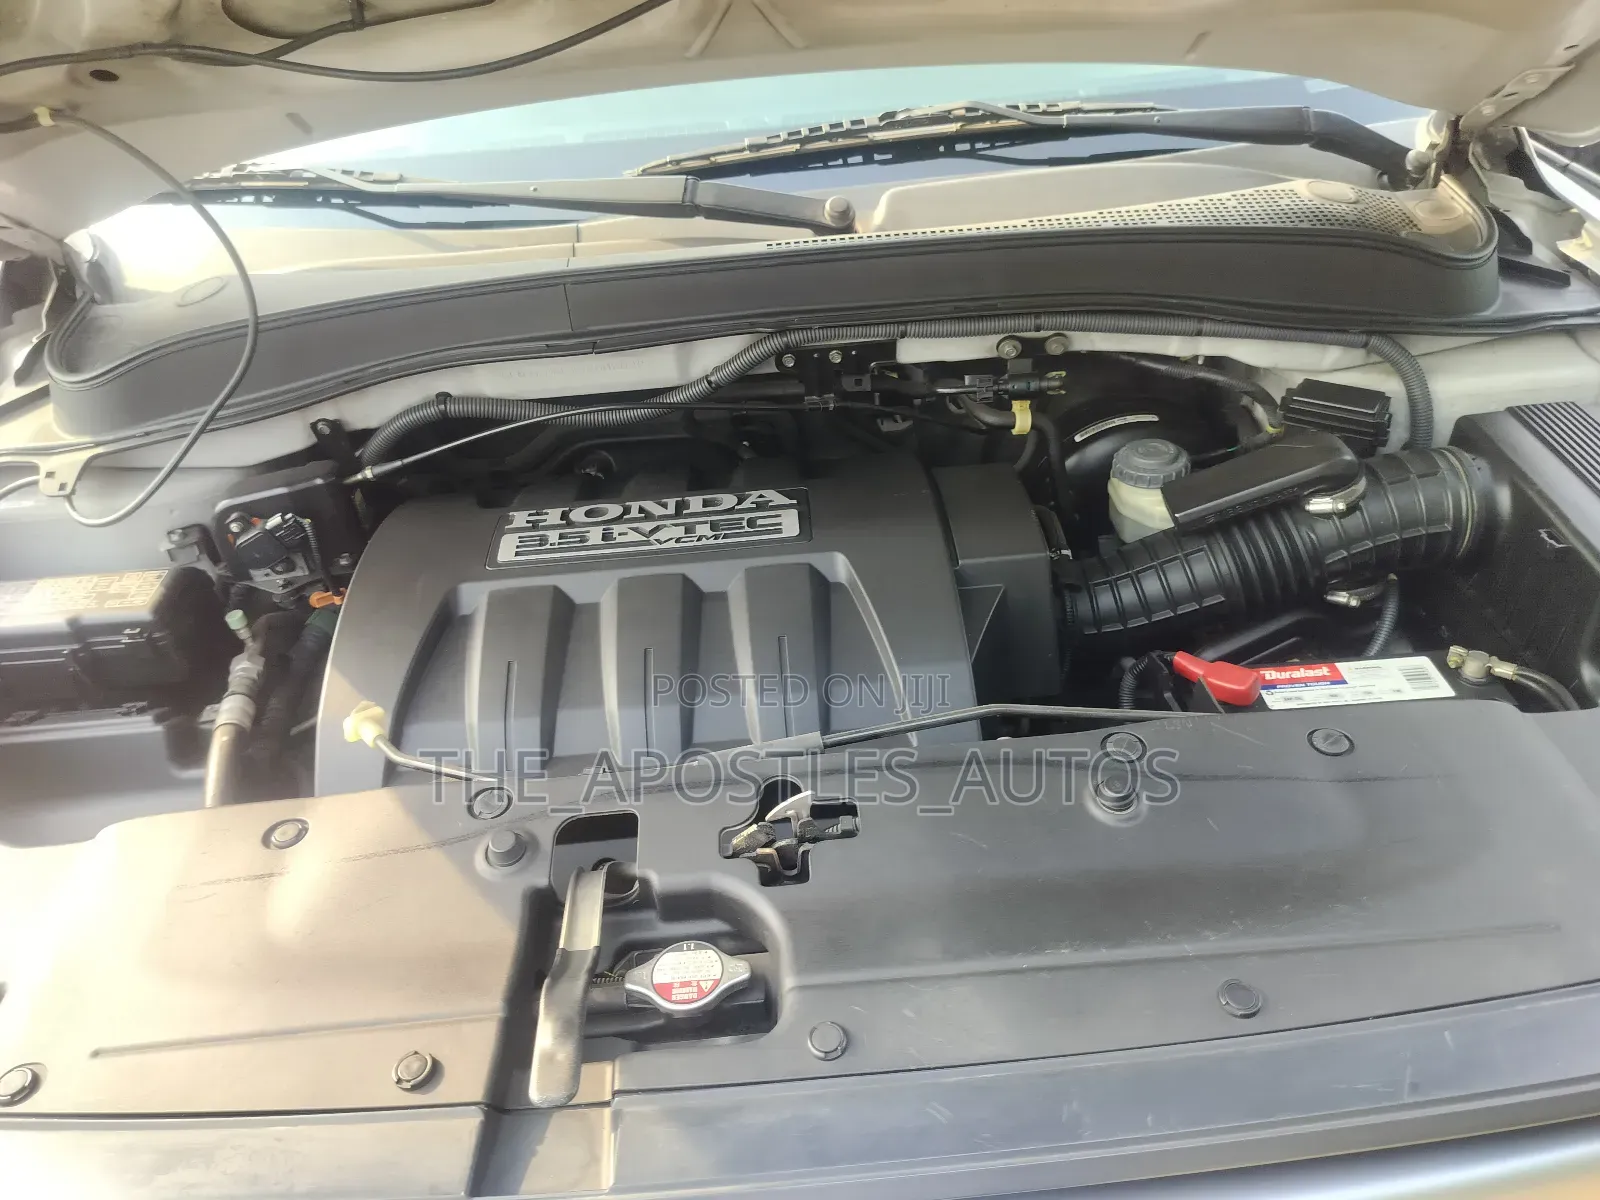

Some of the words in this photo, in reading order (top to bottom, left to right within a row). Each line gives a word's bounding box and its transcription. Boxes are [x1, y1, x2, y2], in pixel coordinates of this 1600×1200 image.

[504, 489, 798, 529] HONDA
[514, 530, 591, 549] 3.5
[601, 513, 784, 541] i-VTEC
[653, 532, 724, 546] VCM
[1259, 666, 1332, 681] Duralast
[683, 943, 695, 951] 1.1
